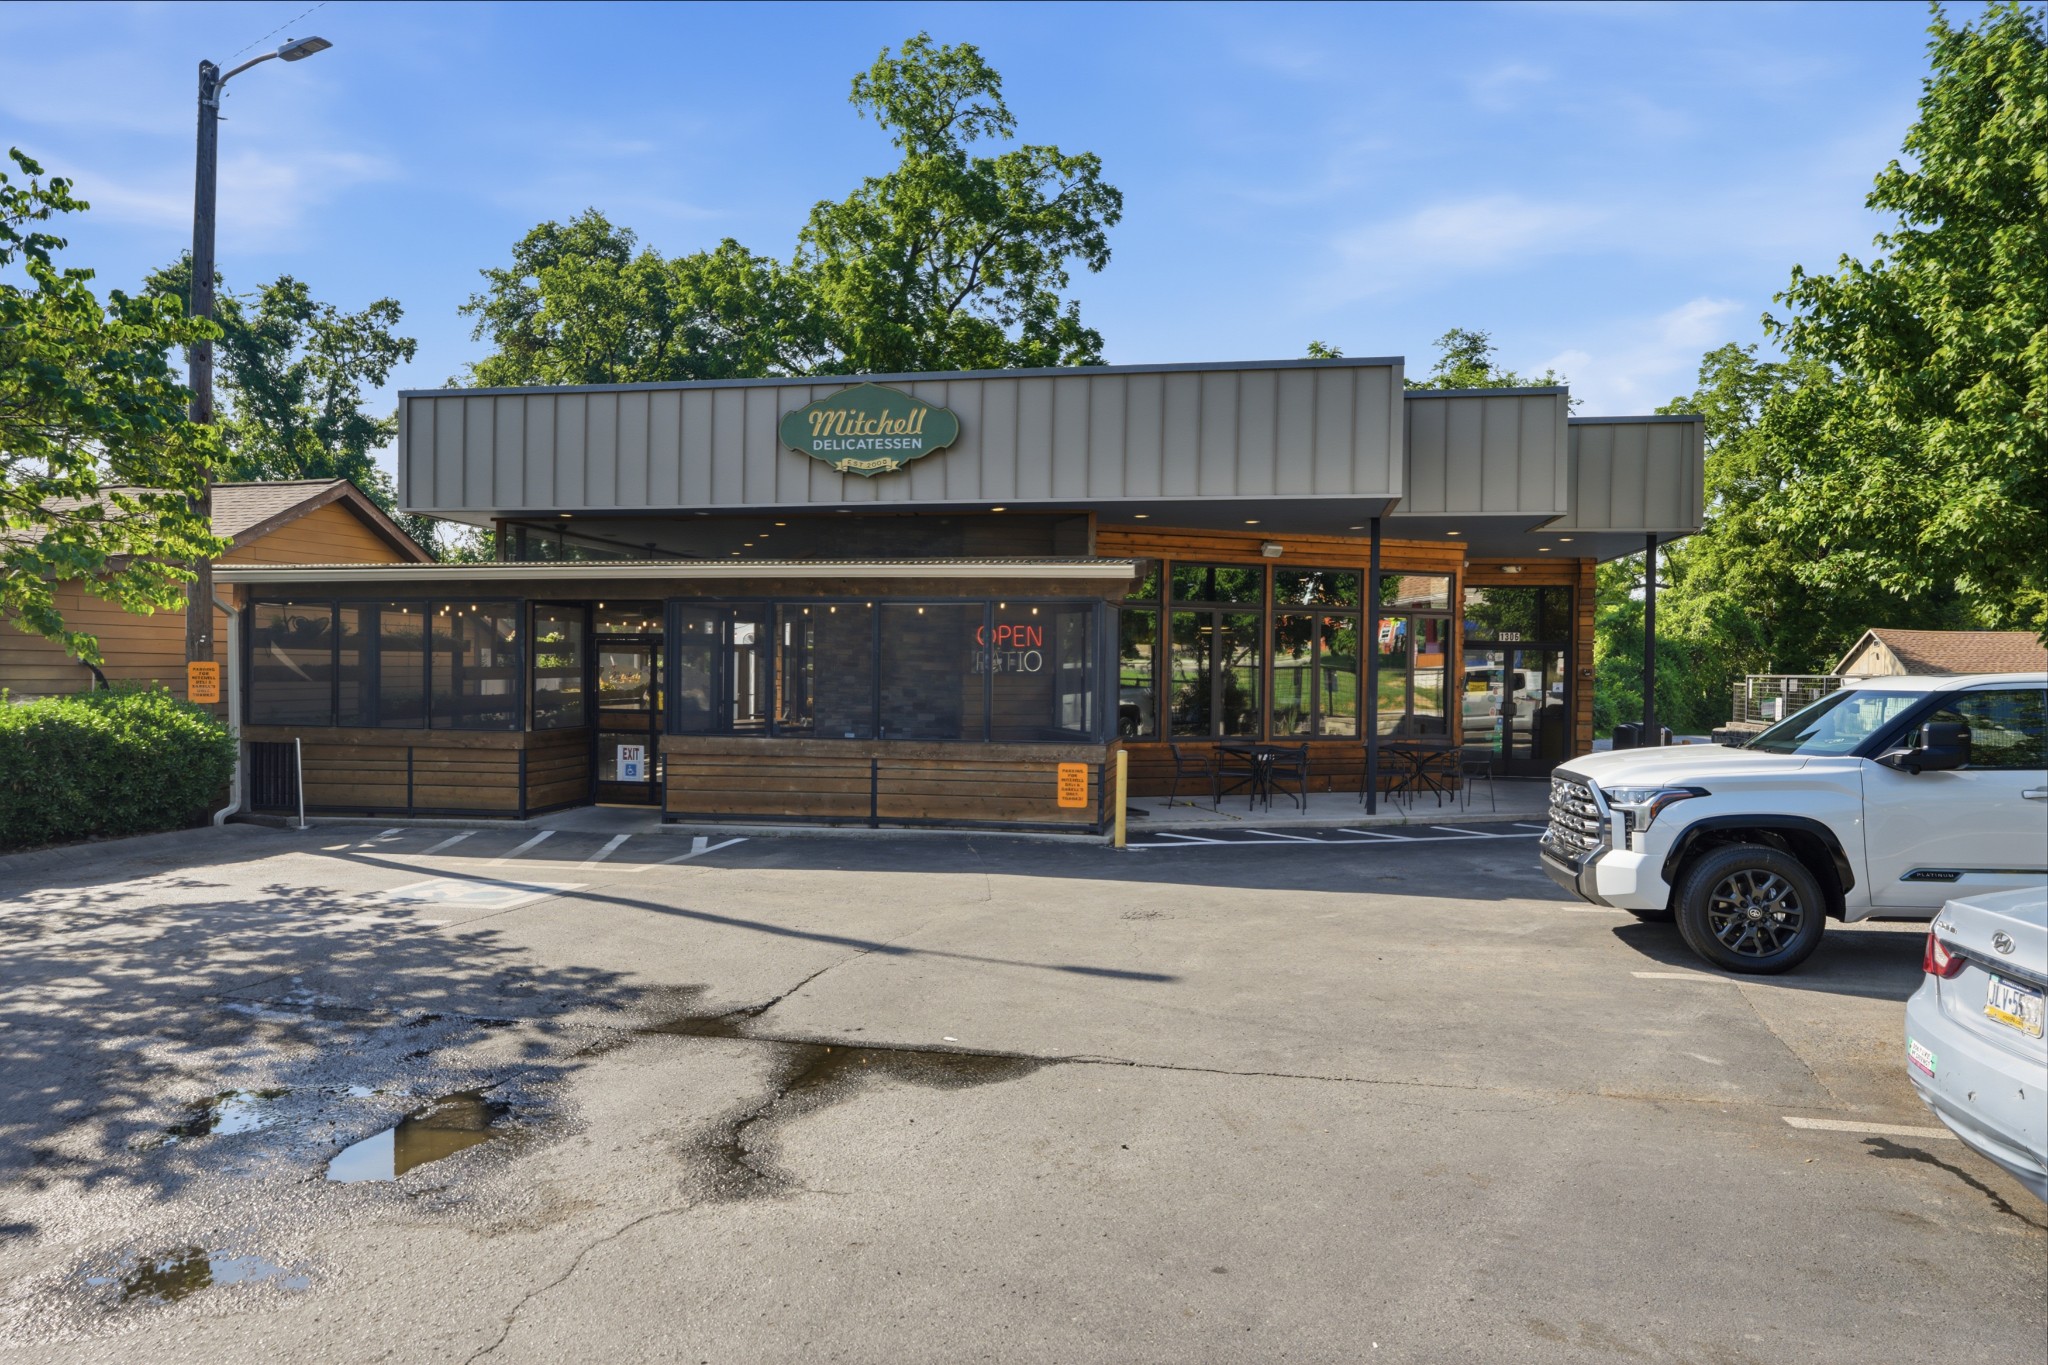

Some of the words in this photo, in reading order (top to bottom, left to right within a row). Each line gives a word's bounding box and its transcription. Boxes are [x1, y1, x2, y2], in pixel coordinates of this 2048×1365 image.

[808, 407, 927, 437] Mitchell
[812, 437, 923, 451] DELICATESSEN
[976, 624, 1043, 647] OPEN
[1500, 632, 1519, 641] 1306
[622, 747, 640, 761] EXIT
